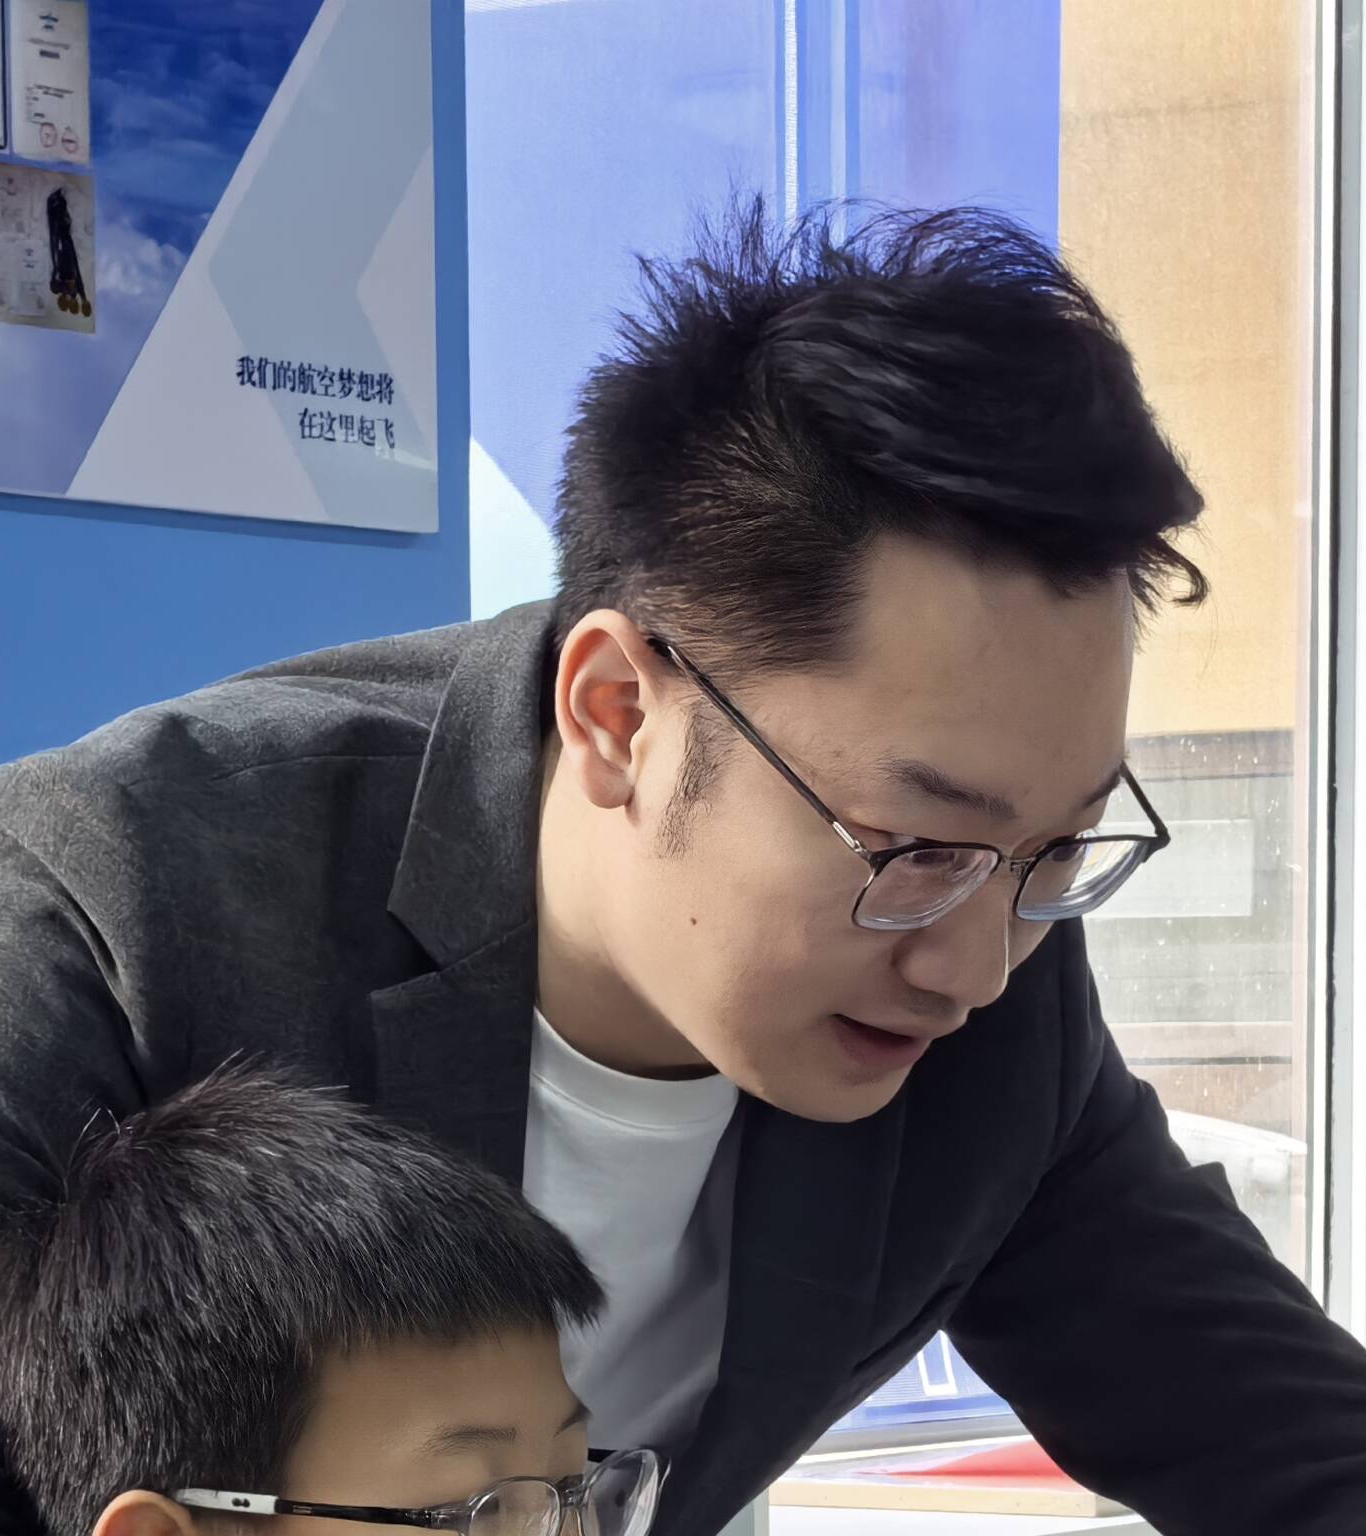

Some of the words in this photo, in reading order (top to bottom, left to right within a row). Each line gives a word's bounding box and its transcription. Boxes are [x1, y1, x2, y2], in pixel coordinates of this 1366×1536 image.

[236, 355, 395, 405] 我们的航空梦想将
[298, 407, 396, 449] 在这里起飞
